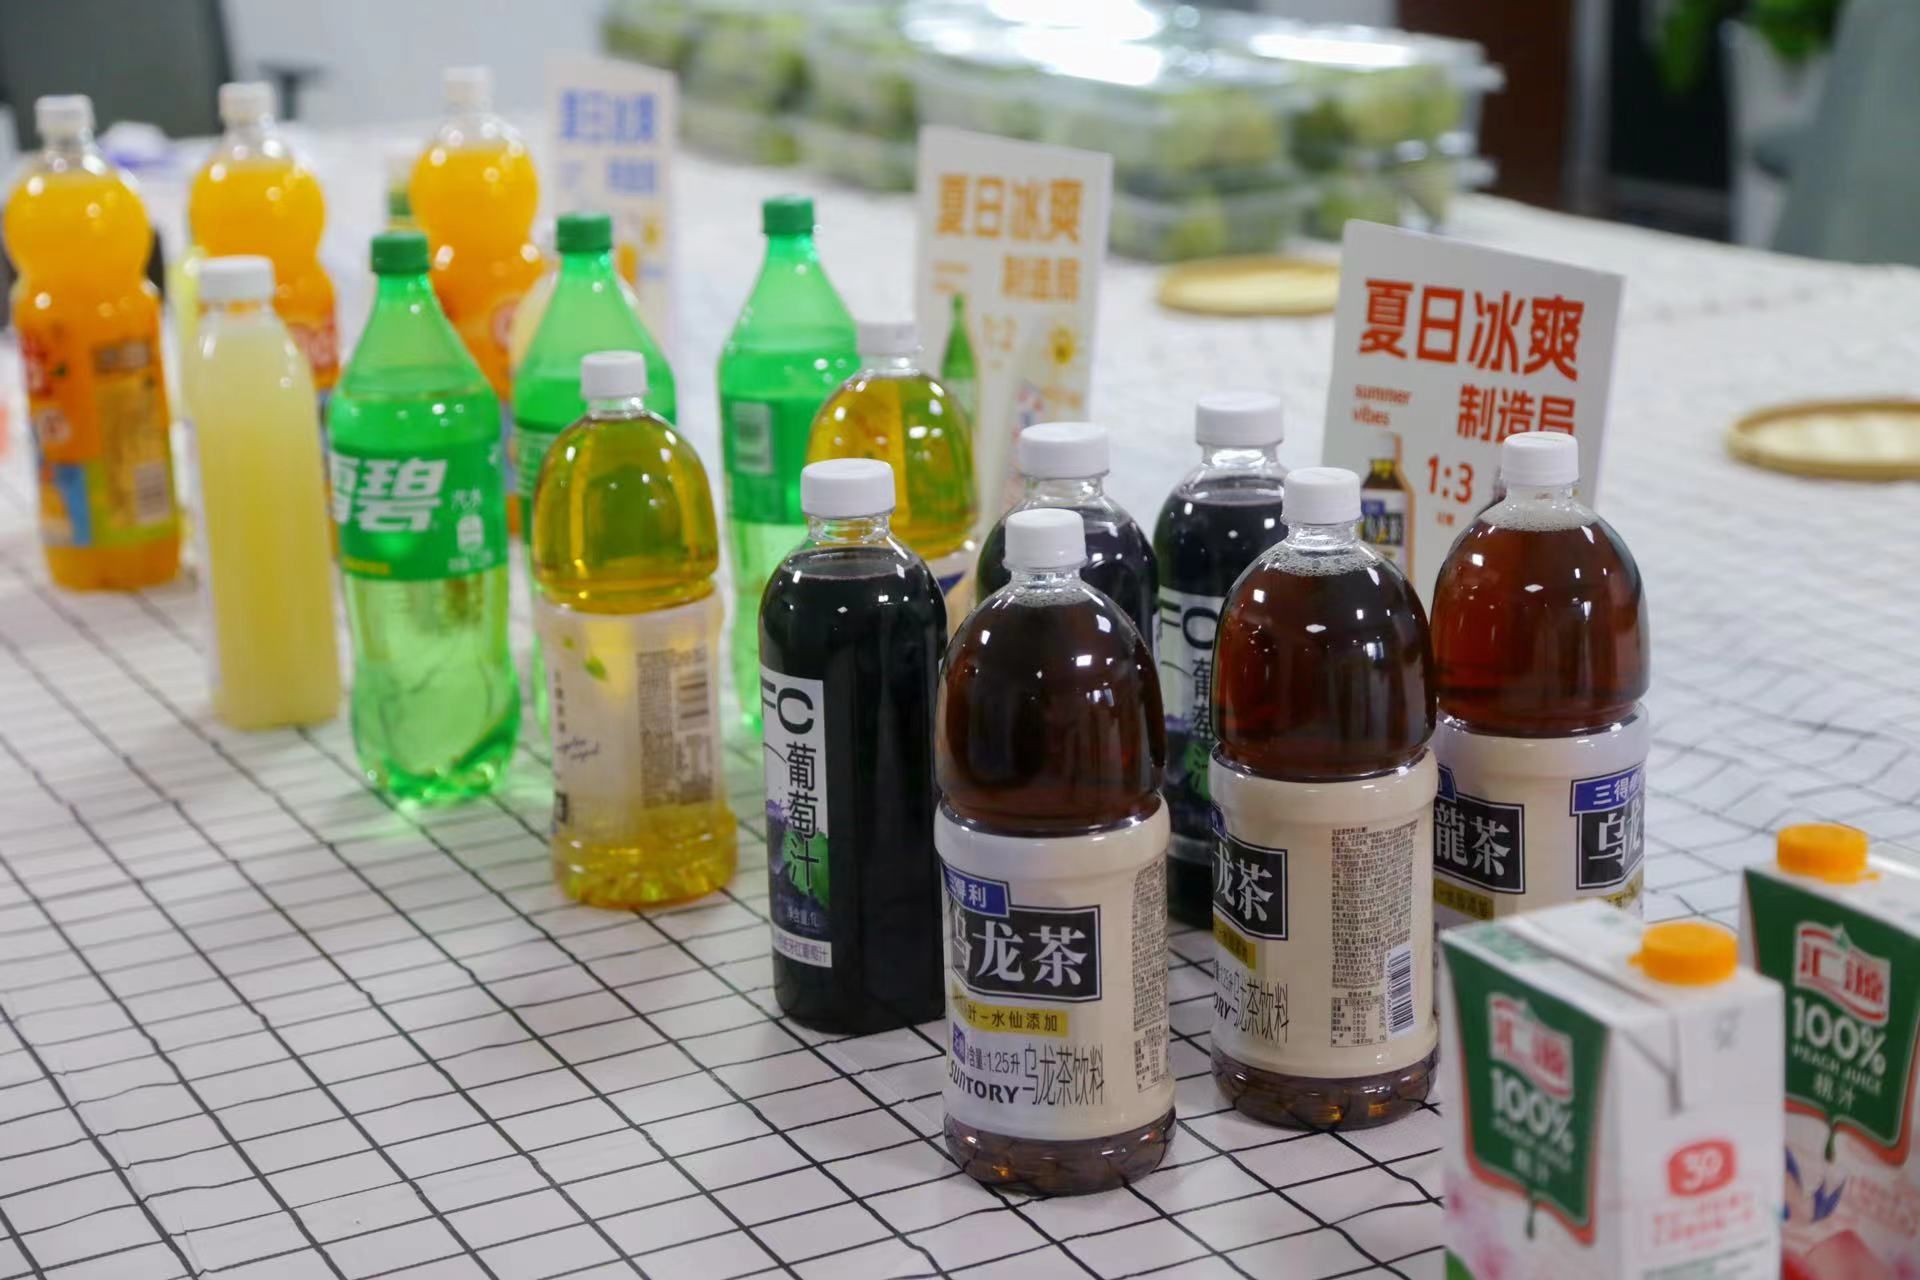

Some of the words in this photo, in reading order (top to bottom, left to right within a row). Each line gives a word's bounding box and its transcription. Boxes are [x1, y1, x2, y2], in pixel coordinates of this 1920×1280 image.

[1358, 278, 1585, 382] 夏日冰爽
[1352, 404, 1391, 427] vibes
[1354, 384, 1411, 405] summer
[1456, 383, 1576, 445] 制造局
[1428, 455, 1474, 504] 1:3
[785, 741, 819, 888] 葡萄汁
[953, 906, 1088, 988] 乌龙茶
[1792, 997, 1887, 1077] 100%
[1022, 1042, 1105, 1107] 乌龙茶饮料
[1490, 1067, 1575, 1153] 100%
